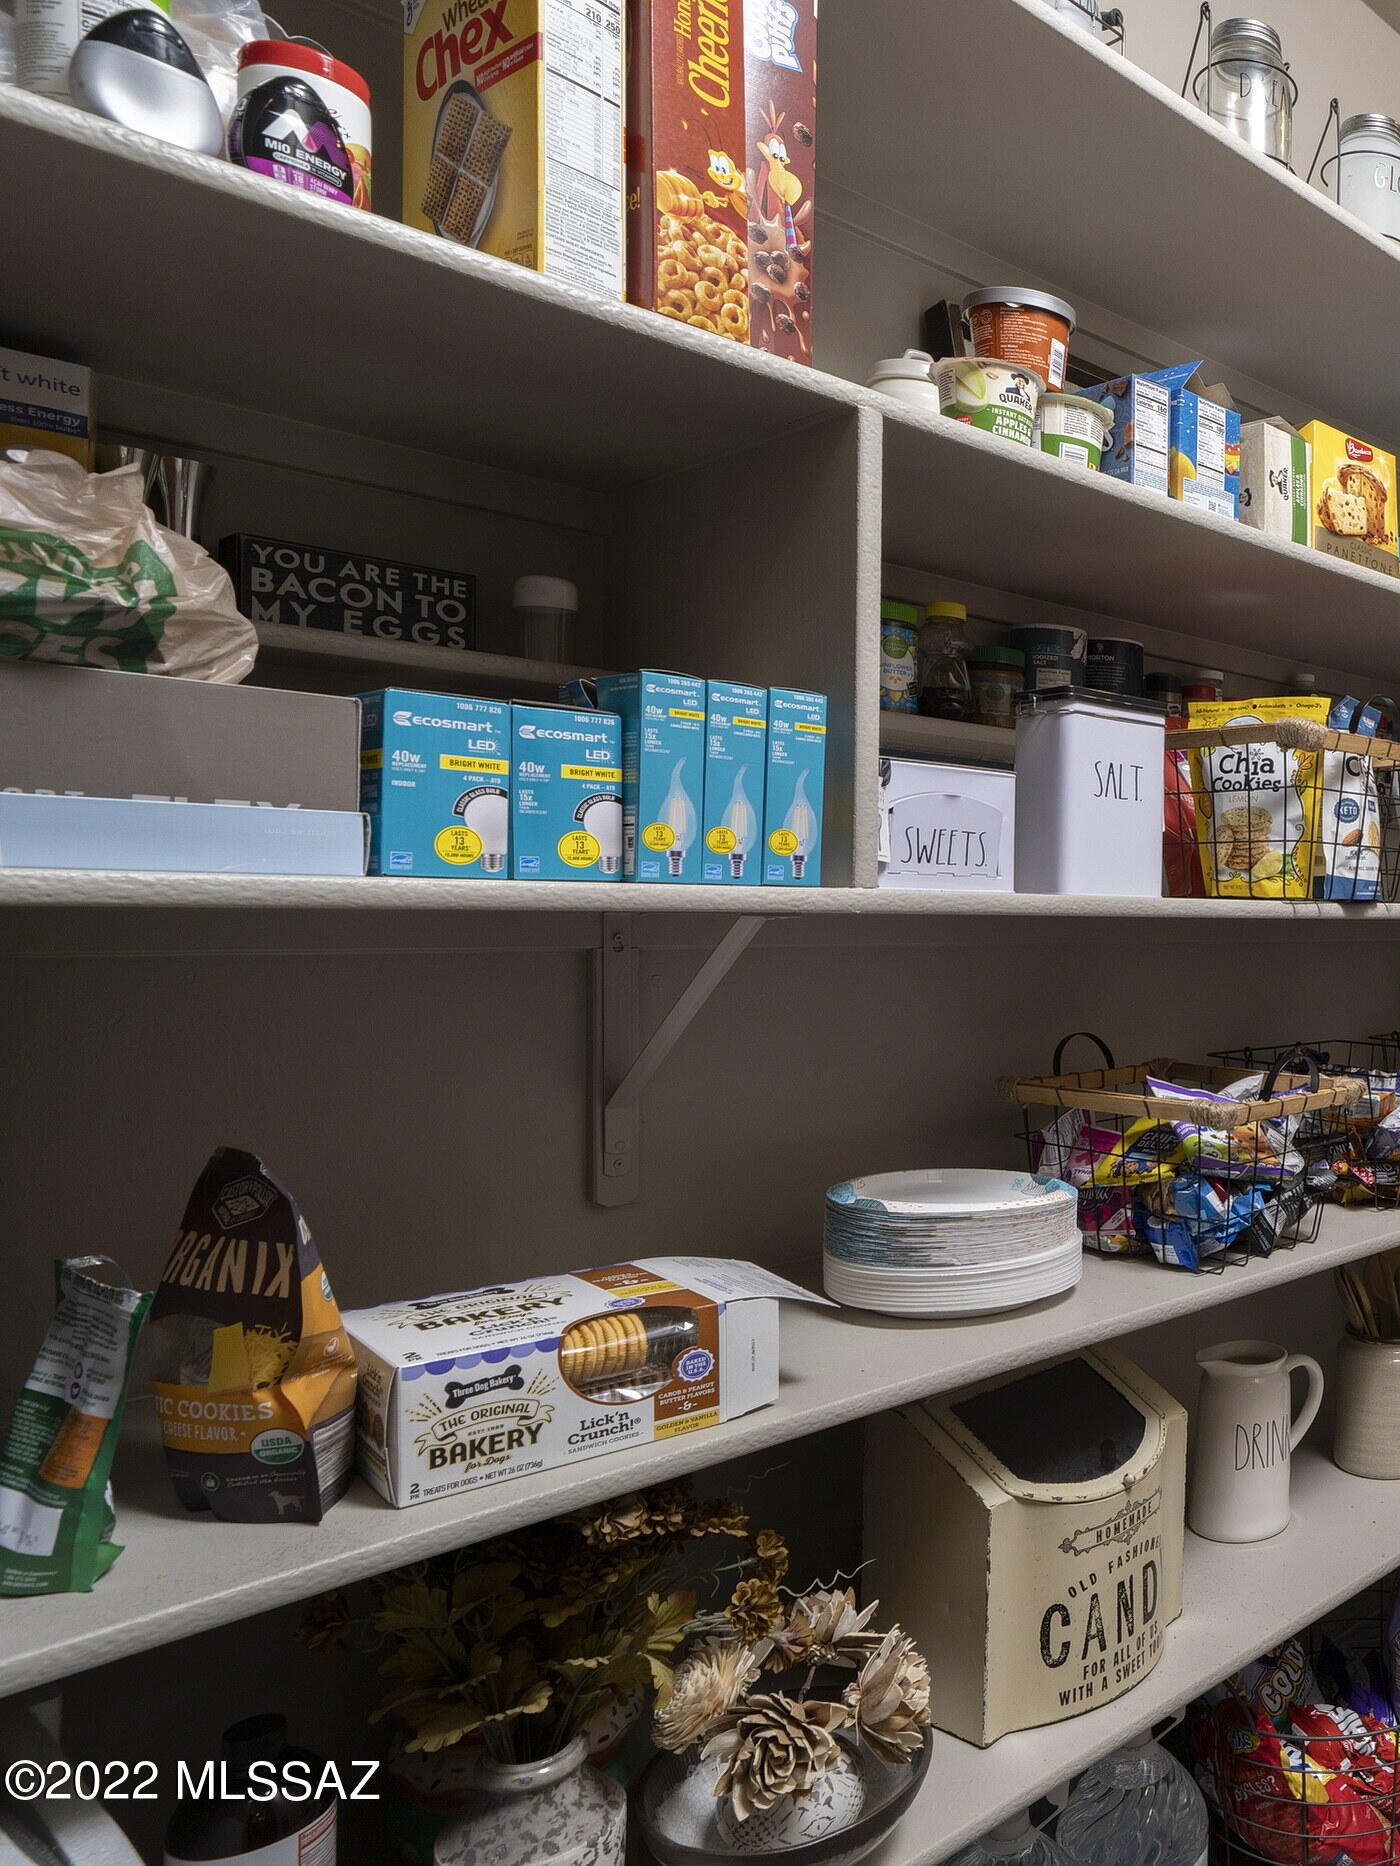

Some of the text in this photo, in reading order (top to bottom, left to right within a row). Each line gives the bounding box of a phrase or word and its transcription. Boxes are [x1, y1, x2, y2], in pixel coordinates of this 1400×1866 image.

[416, 0, 516, 101] Chex
[295, 150, 347, 181] ENERGY
[17, 373, 81, 397] white
[999, 393, 1032, 413] QUAKER
[0, 402, 81, 426] ess Energy
[996, 416, 1027, 433] APPLES
[1326, 542, 1394, 576] PANETTONE
[250, 543, 467, 598] YOU ARE THE
[250, 566, 467, 623] BACON TO
[250, 600, 467, 651] MY EGGS
[655, 686, 697, 697] ecosmart
[720, 695, 759, 706] ecosmart
[645, 705, 663, 714] 40w
[745, 707, 760, 715] LED
[782, 702, 820, 713] ecosmart
[412, 716, 493, 733] ecosmart
[711, 713, 728, 722] 40w
[773, 719, 790, 729] 40w
[536, 728, 608, 744] ecosmart
[468, 739, 496, 752] LED
[585, 749, 611, 760] LED
[392, 750, 421, 763] 40w
[449, 759, 501, 771] BRIGHT WHITE
[1219, 751, 1275, 776] Chia
[519, 761, 545, 773] 40w
[569, 768, 616, 779] BRIGHT WHITE
[1212, 774, 1281, 793] Cookies
[455, 837, 465, 846] 13
[576, 841, 585, 850] 13
[415, 1298, 565, 1331] BAKERY
[686, 1355, 706, 1366] BAKED
[452, 1374, 516, 1398] Three Dog Bakery
[658, 1388, 682, 1400] CAROB
[688, 1382, 715, 1393] PEANUT
[660, 1388, 715, 1406] BUTTER FLAVORS
[178, 1401, 274, 1421] COOKIES
[439, 1403, 531, 1432] THE ORIGINAL
[656, 1419, 683, 1432] GOLDEN
[691, 1411, 719, 1423] VANILLA
[674, 1423, 700, 1433] FLAVOR
[194, 1424, 236, 1441] FLAVOR
[261, 1437, 292, 1447] USDA
[429, 1423, 544, 1470] BAKERY
[568, 1432, 639, 1455] SANDWICH COOKIES
[259, 1447, 299, 1458] ORGANIC
[464, 1454, 512, 1474] for Dogs
[410, 1483, 420, 1494] 2
[423, 1485, 446, 1497] TREATS
[447, 1481, 460, 1491] FOR
[460, 1476, 478, 1488] DOGS
[485, 1470, 497, 1481] NET
[497, 1468, 507, 1477] WT
[508, 1466, 516, 1475] 26
[516, 1464, 524, 1473] OZ
[1096, 1501, 1152, 1543] HOMEMADE
[1068, 1534, 1161, 1598] OLD FASHIONE
[1040, 1559, 1158, 1668] CAND
[1083, 1620, 1158, 1681] FOR ALL OF US
[1059, 1651, 1145, 1706] WITH A SWEET
